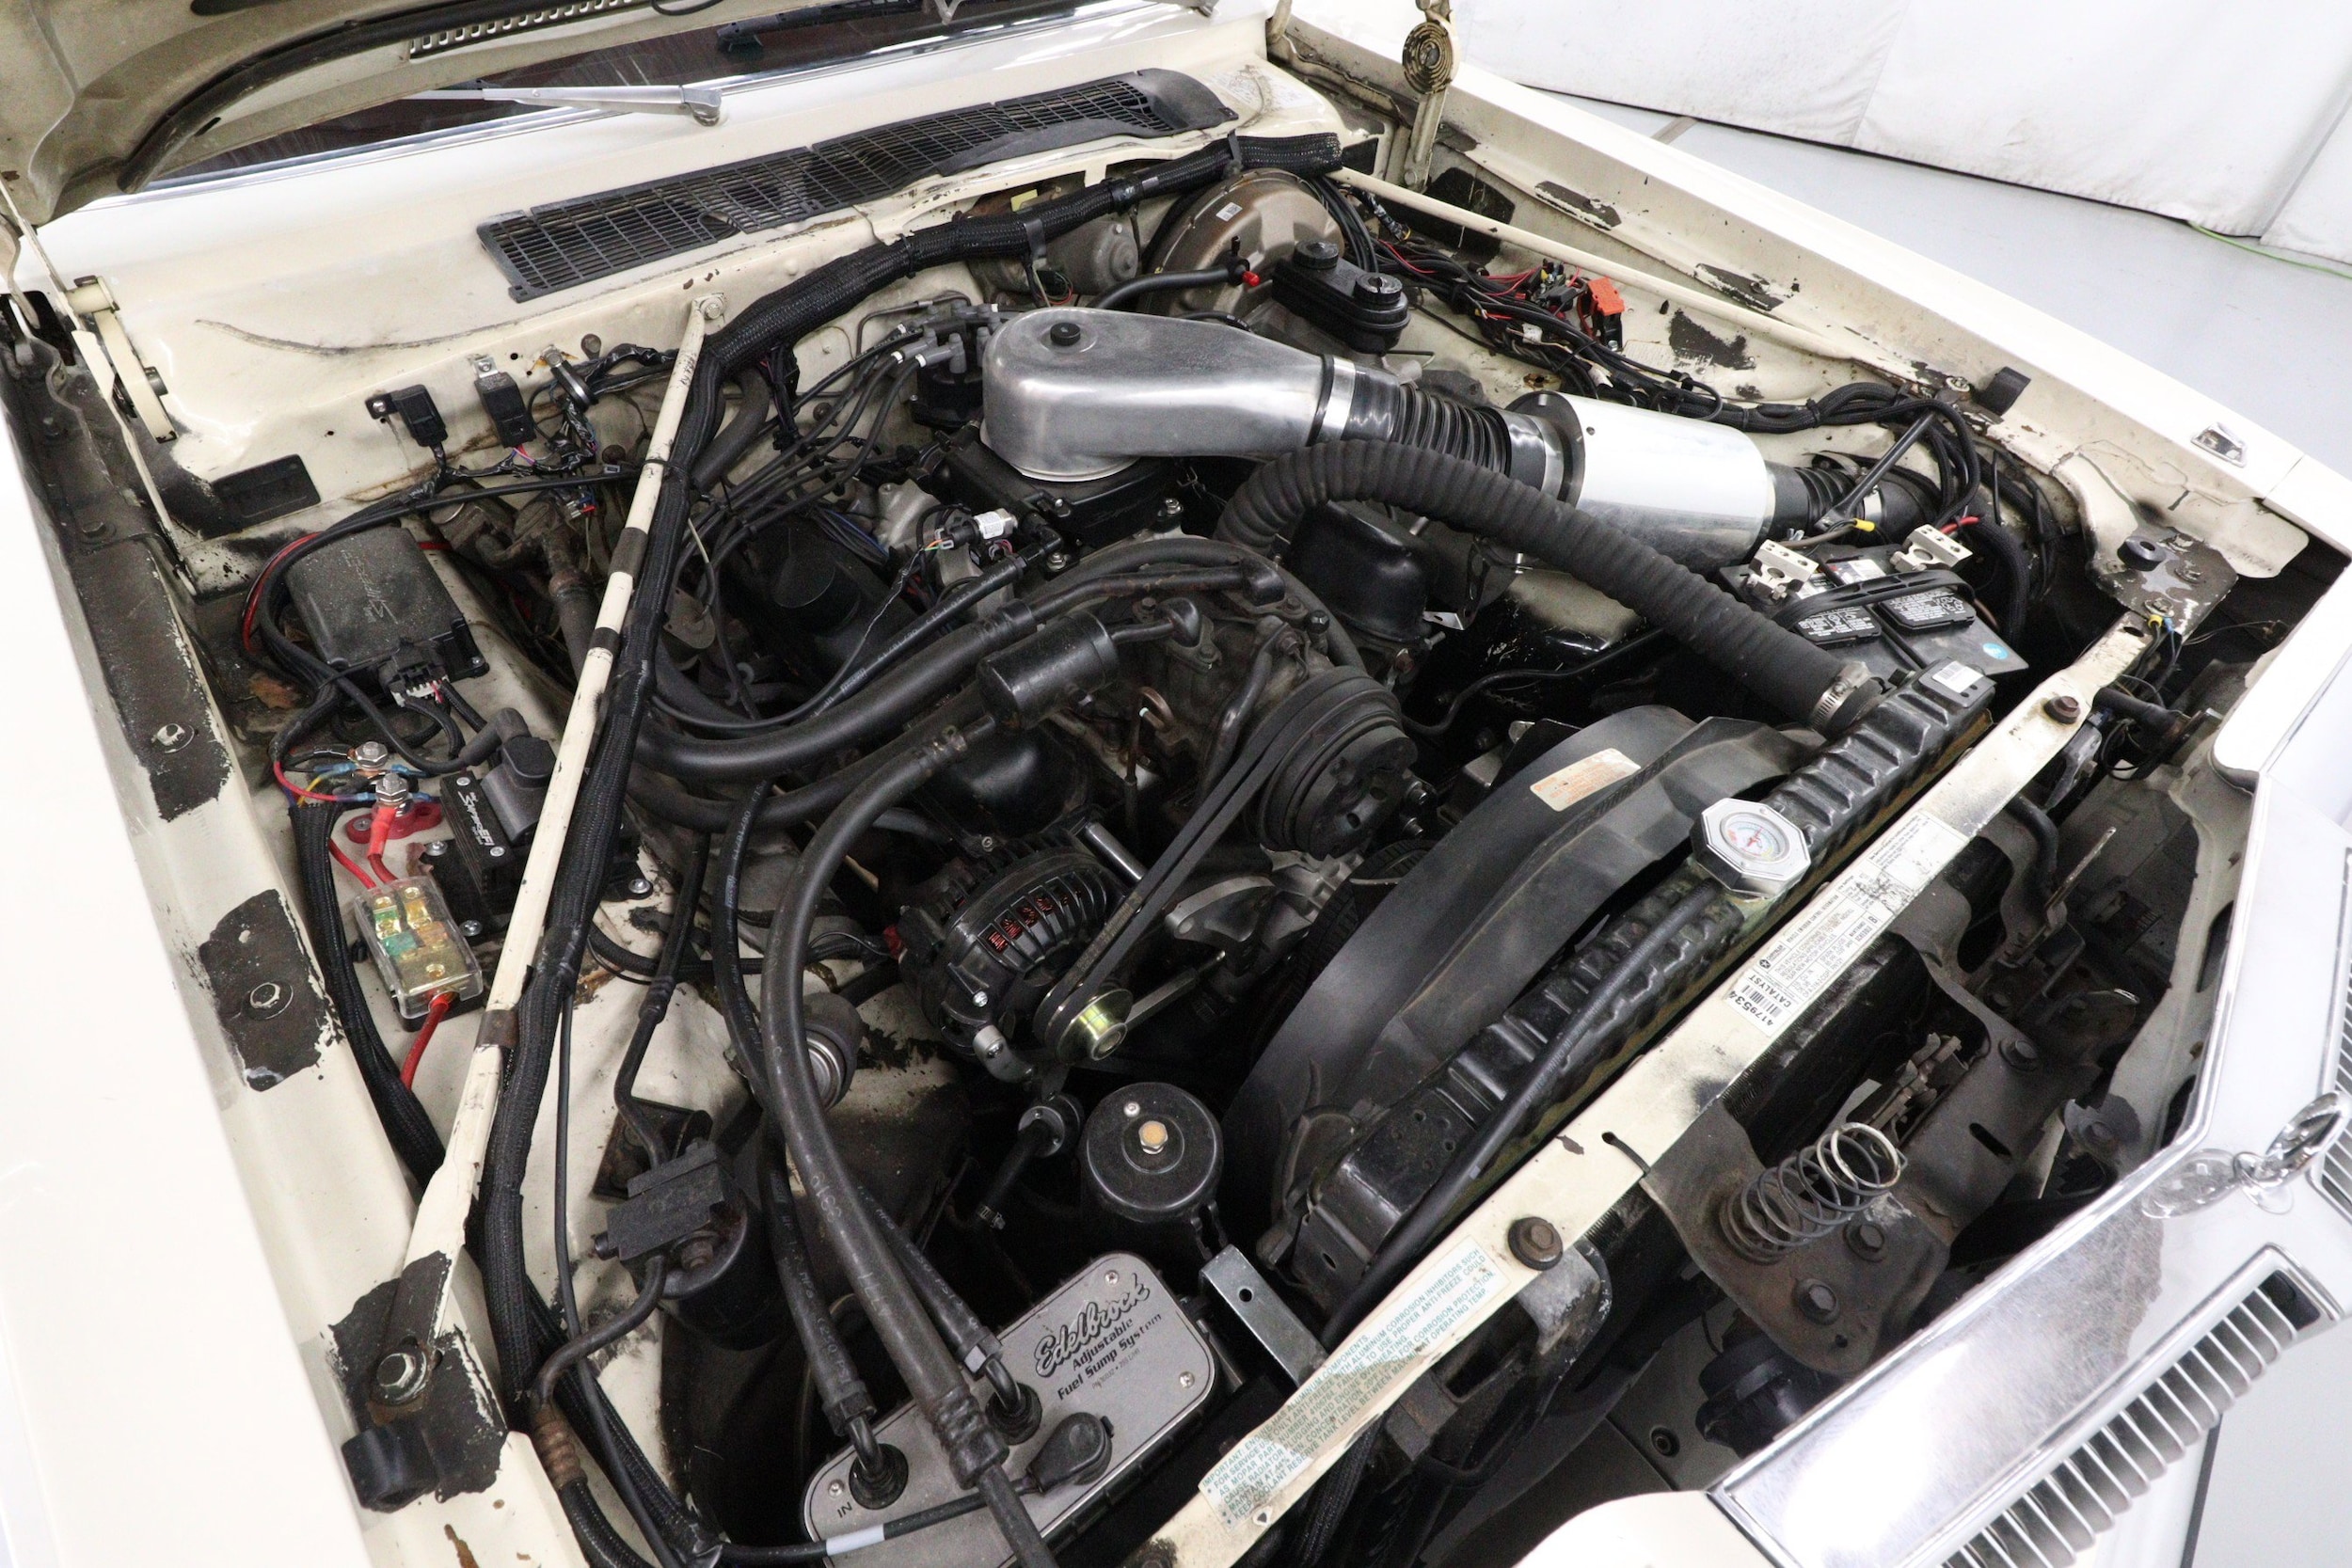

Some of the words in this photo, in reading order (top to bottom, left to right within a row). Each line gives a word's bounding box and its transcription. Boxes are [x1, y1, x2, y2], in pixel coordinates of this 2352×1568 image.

[479, 828, 495, 845] EFI
[1748, 974, 1791, 1007] CATALYST
[1784, 948, 1801, 965] VEHICLE
[1795, 961, 1806, 973] NEW
[1804, 948, 1820, 964] MOTOR
[1729, 990, 1773, 1025] 4179534
[1545, 1048, 1565, 1073] CHINA
[1035, 1274, 1152, 1378] Edelbrock
[1056, 1371, 1085, 1401] Fuel
[1084, 1347, 1119, 1377] Sump
[1118, 1313, 1162, 1350] System
[1070, 1317, 1134, 1371] Adjustable
[1213, 1472, 1230, 1488] FOR
[1228, 1446, 1260, 1475] SERVICE
[1258, 1433, 1274, 1449] USE
[1272, 1416, 1293, 1436] ONLY
[1291, 1377, 1335, 1418] ANTI-FREEZE
[1333, 1361, 1352, 1380] WITH
[1350, 1329, 1387, 1364] ALUMINUM
[1385, 1293, 1426, 1332] CORROSION
[1423, 1262, 1463, 1297] INHIBITORS
[1460, 1247, 1480, 1266] SUCH
[1217, 1484, 1230, 1496] AS
[1230, 1460, 1257, 1485] MOPAR
[1257, 1442, 1277, 1461] PART
[1278, 1414, 1309, 1443] NUMBER
[1336, 1360, 1366, 1389] FAILURE
[1366, 1350, 1377, 1362] TO
[1376, 1336, 1392, 1352] USE
[1391, 1310, 1421, 1338] PROPER
[1461, 1254, 1486, 1276] COULD
[1227, 1478, 1264, 1512] MAINTAIN
[1262, 1468, 1274, 1481] AT
[1305, 1387, 1363, 1442] CONCENTRATION
[1398, 1339, 1415, 1357] FOR
[1412, 1305, 1454, 1343] CORROSION
[1452, 1269, 1496, 1307] PROTECTION.
[1244, 1423, 1273, 1449] ENGINE
[1270, 1409, 1287, 1426] HAS
[1285, 1376, 1323, 1412] ALUMINUM
[1321, 1333, 1370, 1379] COMPONENTS.
[1222, 1480, 1248, 1504] CAUSE
[1247, 1448, 1284, 1482] RADIATOR
[1282, 1416, 1319, 1450] PLUGGING
[1317, 1402, 1335, 1418] AND
[1333, 1377, 1360, 1403] ENGINE
[1359, 1332, 1410, 1380] OVERHEATING.
[1232, 1498, 1254, 1520] KEEP
[1251, 1468, 1288, 1502] COOLANT
[1286, 1440, 1319, 1472] RESERVE
[1318, 1422, 1339, 1442] TANK
[1337, 1403, 1359, 1425] LEVEL
[1358, 1372, 1392, 1405] BETWEEN
[1419, 1337, 1431, 1349] AT
[1429, 1303, 1469, 1339] OPERATING
[835, 1500, 854, 1518] IN
